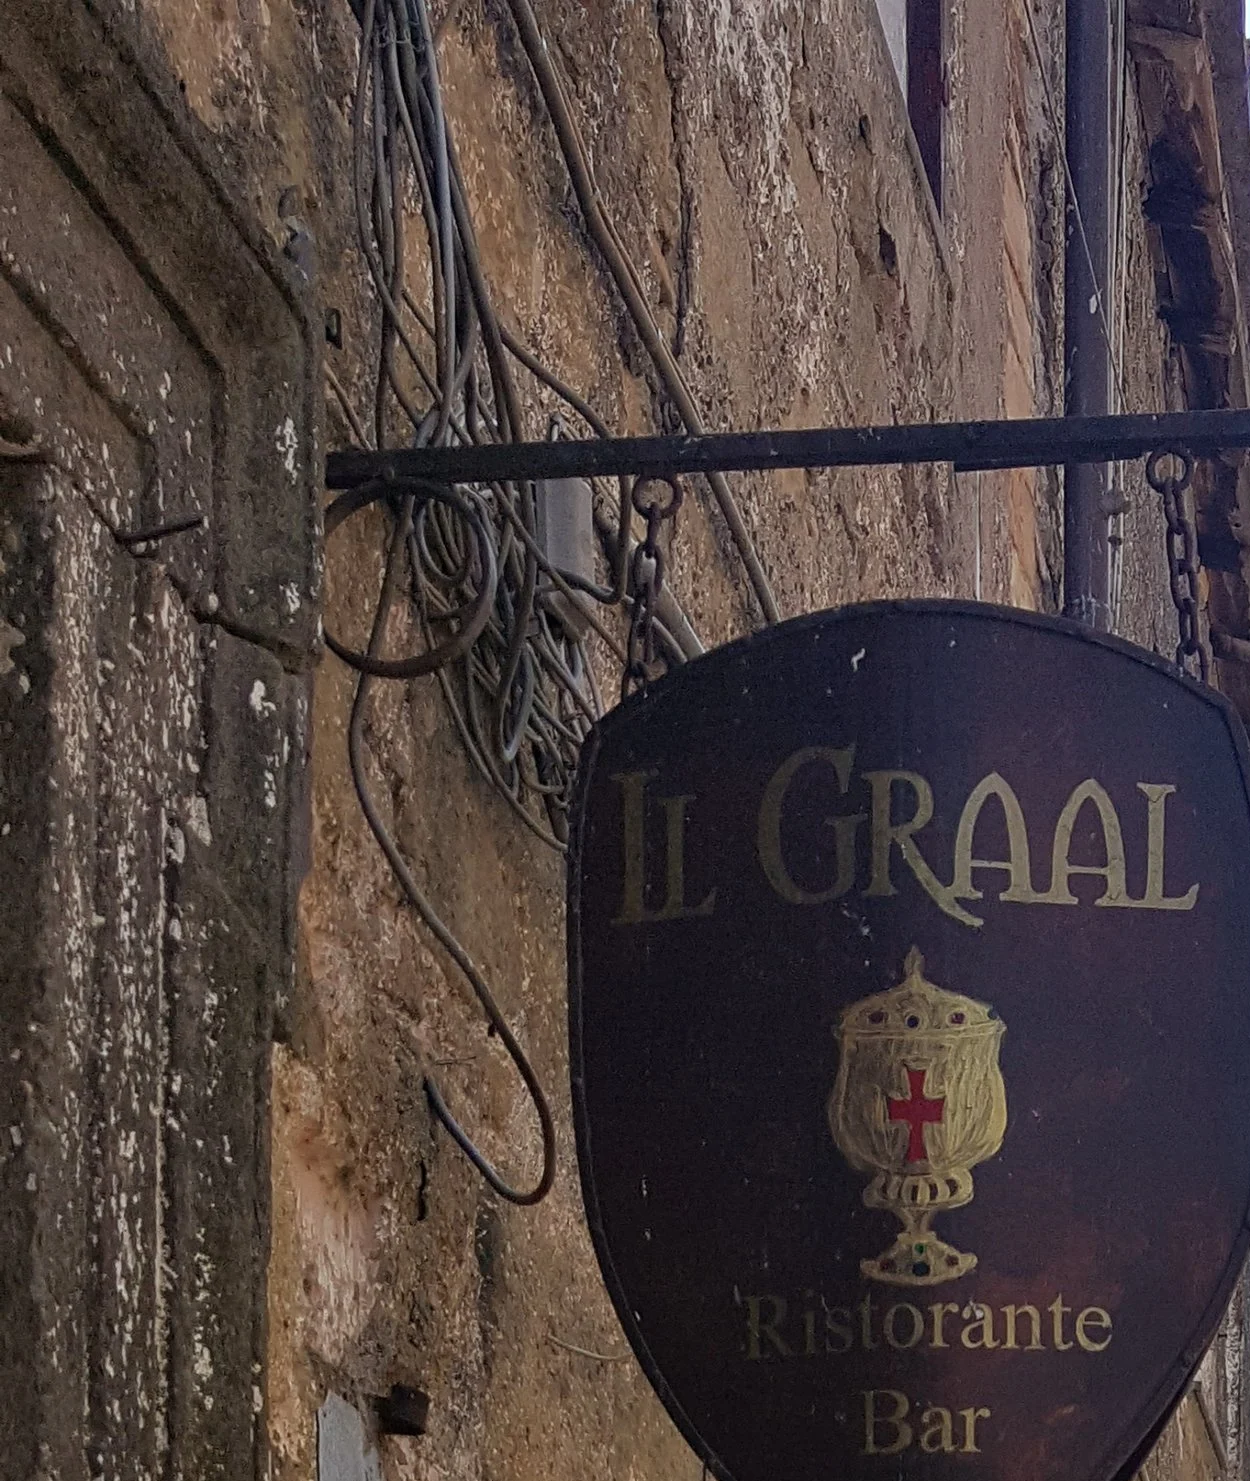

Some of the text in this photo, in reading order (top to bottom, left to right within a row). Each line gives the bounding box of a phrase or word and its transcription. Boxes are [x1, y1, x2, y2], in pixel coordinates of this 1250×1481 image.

[609, 743, 1200, 927] IL GRAAL
[744, 1288, 1113, 1360] Ristorante
[860, 1388, 991, 1455] Bar
